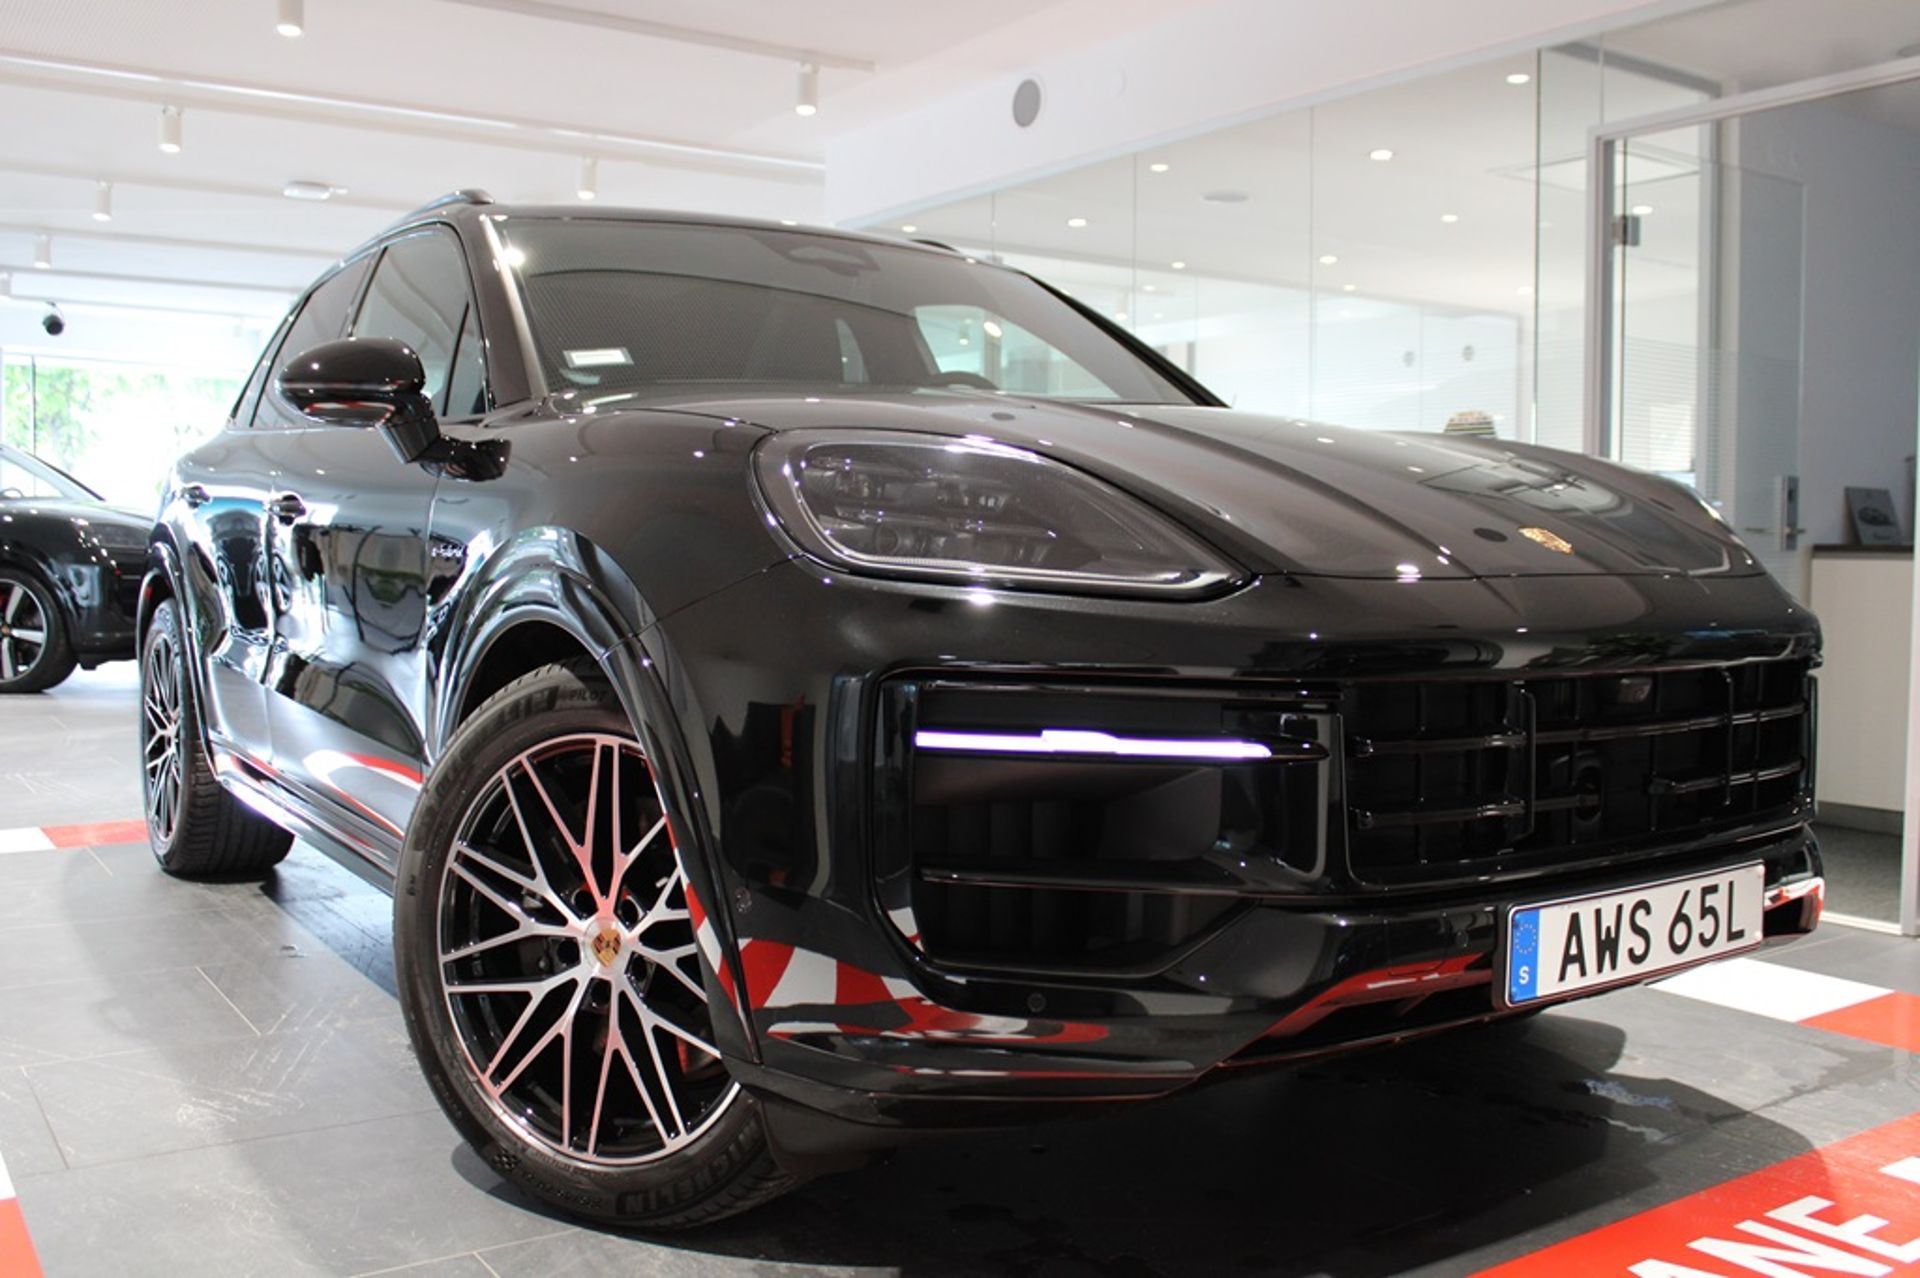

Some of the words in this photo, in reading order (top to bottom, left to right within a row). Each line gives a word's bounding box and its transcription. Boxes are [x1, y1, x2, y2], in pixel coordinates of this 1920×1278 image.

[1558, 899, 1652, 982] AWS
[1668, 880, 1745, 955] 65L
[1518, 966, 1530, 985] S
